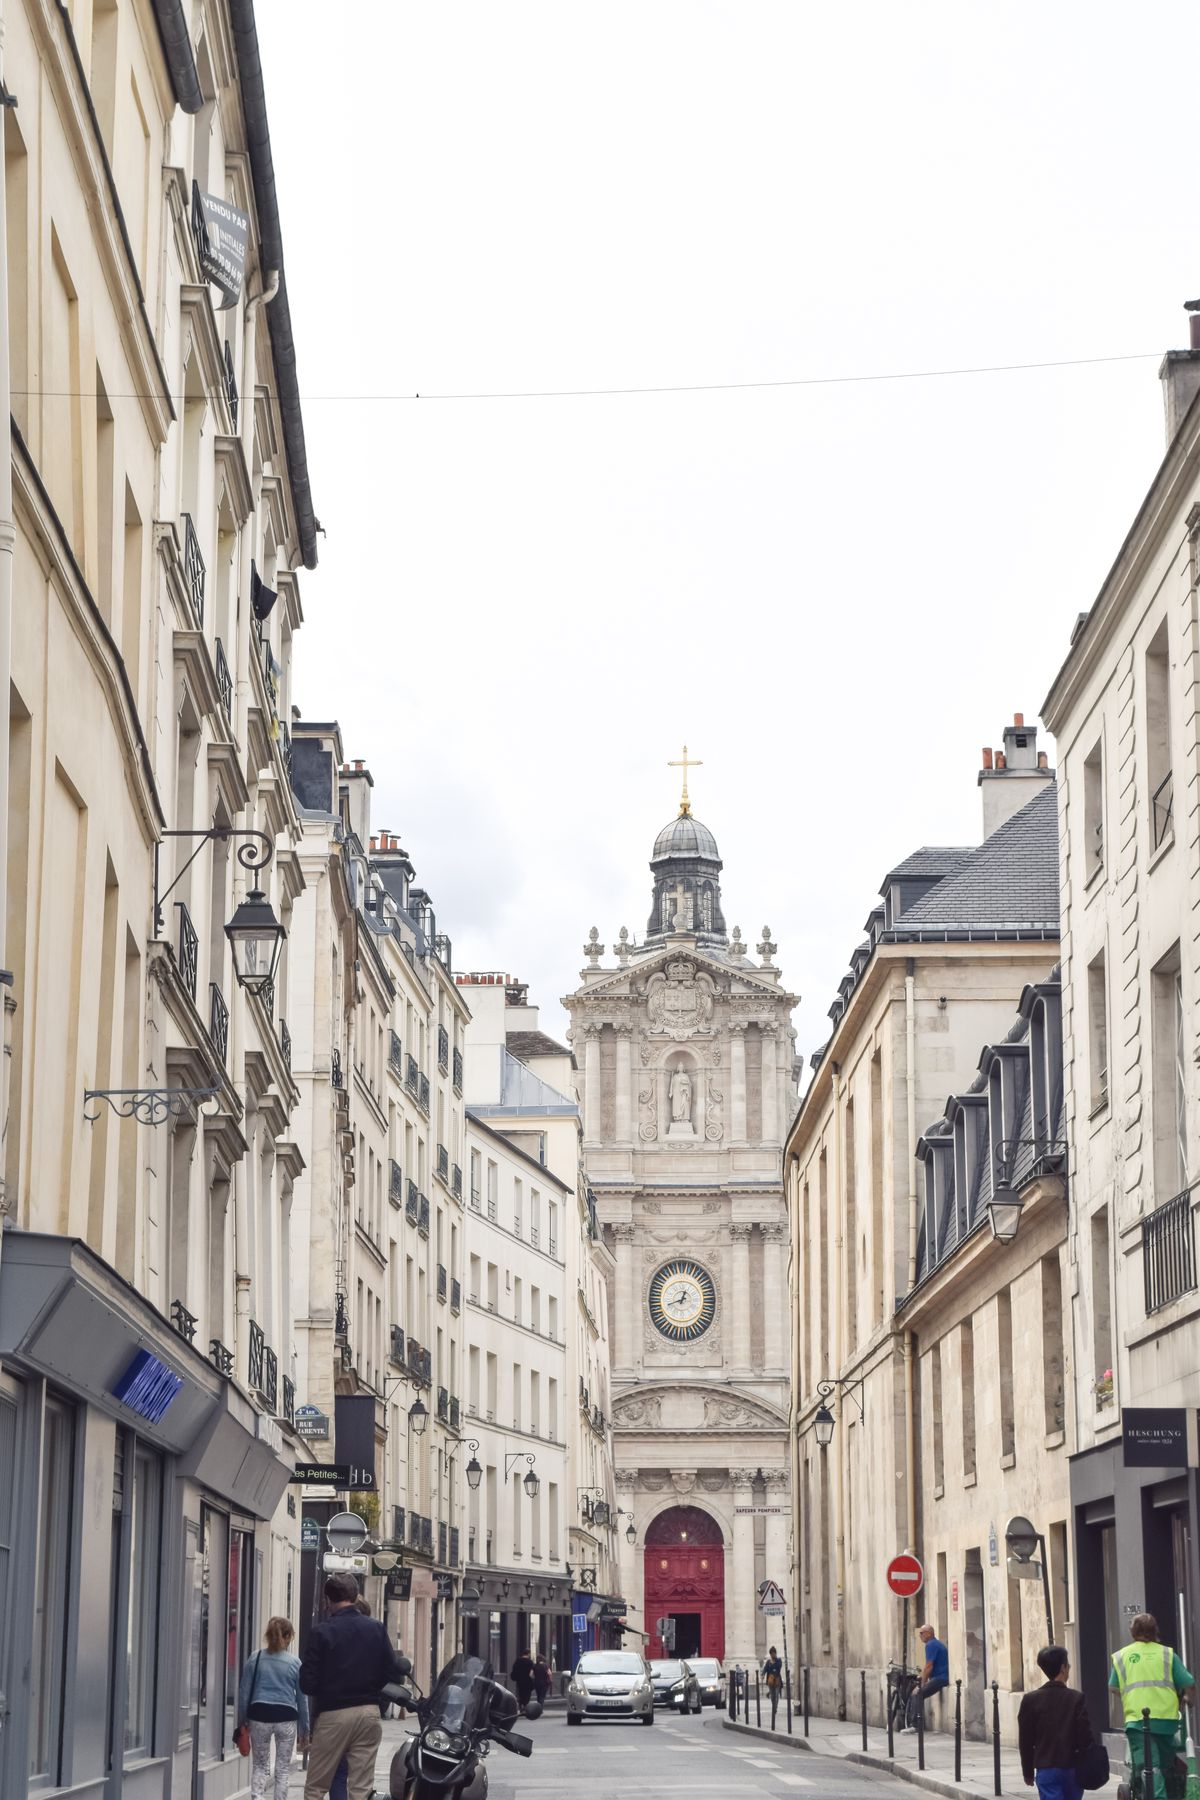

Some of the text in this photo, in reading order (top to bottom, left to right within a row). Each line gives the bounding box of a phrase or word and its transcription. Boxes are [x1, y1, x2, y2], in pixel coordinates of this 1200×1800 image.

[203, 197, 247, 231] VENDU PAR
[220, 228, 245, 257] INITIALES
